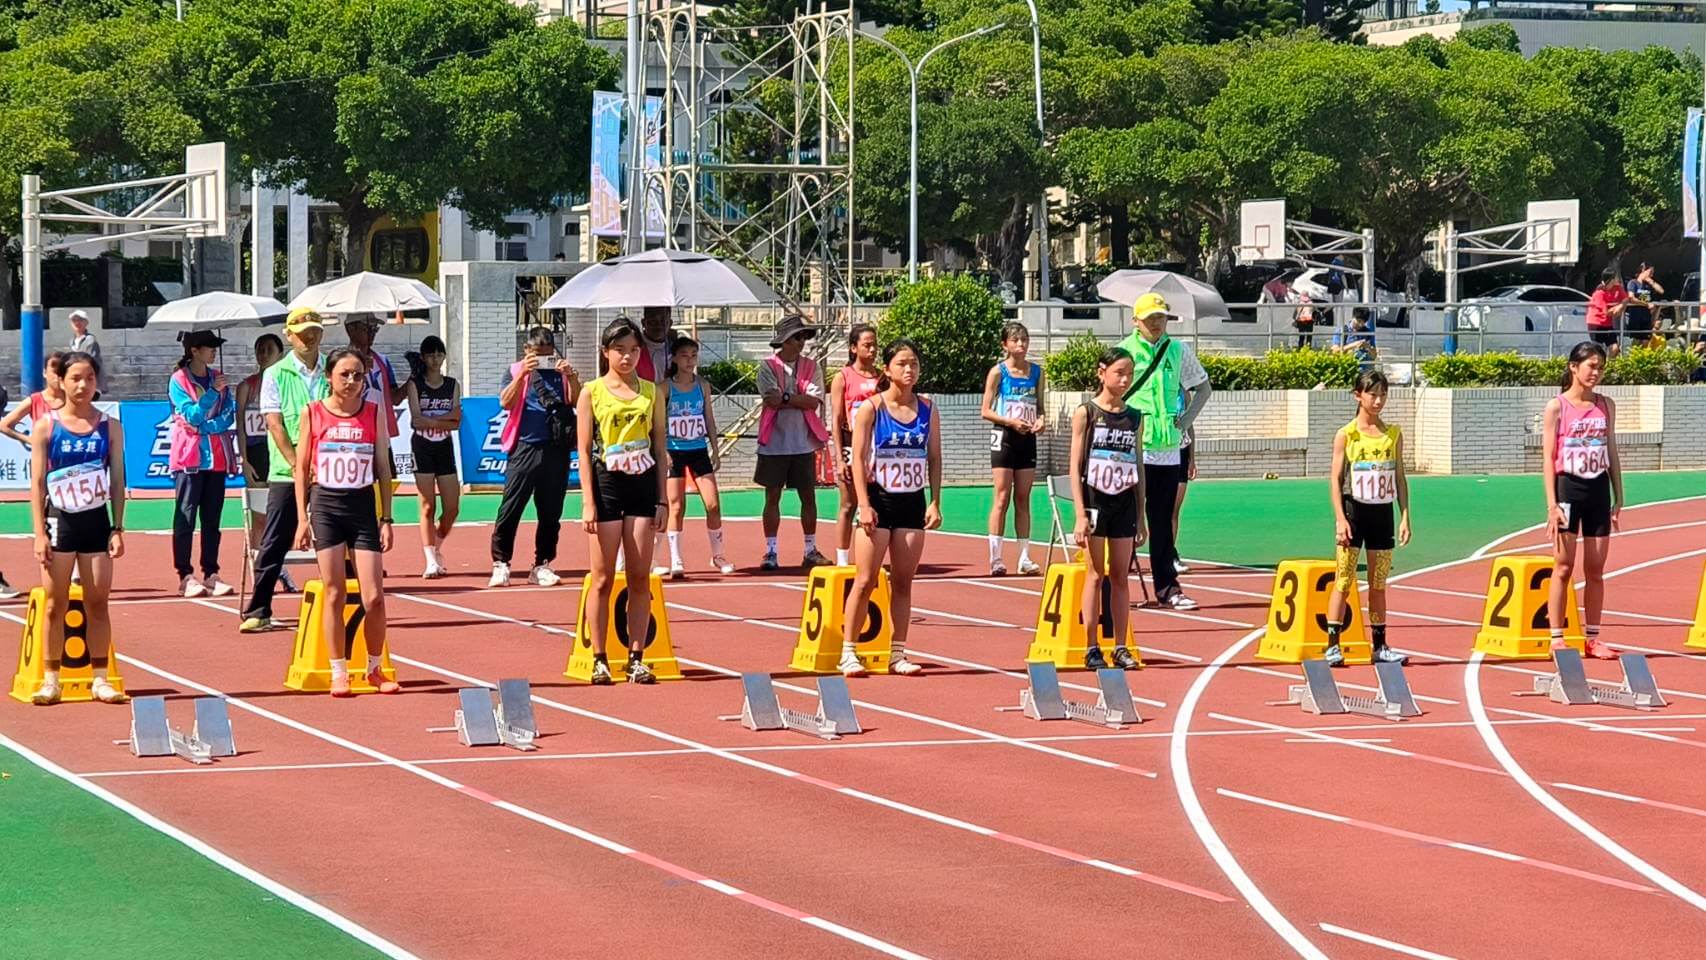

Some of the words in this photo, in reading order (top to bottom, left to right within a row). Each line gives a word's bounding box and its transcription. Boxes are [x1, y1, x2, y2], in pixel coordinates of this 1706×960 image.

[671, 419, 704, 438] 1075
[991, 433, 999, 447] 2
[54, 475, 107, 510] 1154
[321, 456, 370, 484] 1097
[880, 462, 923, 489] 1258
[1091, 463, 1134, 491] 1034
[1356, 475, 1395, 500] 1184
[1567, 450, 1609, 475] 1364
[300, 591, 315, 659] 7
[614, 586, 657, 650] 6
[806, 576, 826, 642] 5
[841, 577, 883, 643] 5
[1043, 573, 1064, 638] 4
[1275, 570, 1298, 633] 3
[1315, 571, 1353, 635] 3
[1489, 566, 1515, 629] 2
[1529, 567, 1569, 630] 2
[24, 599, 36, 667] 8
